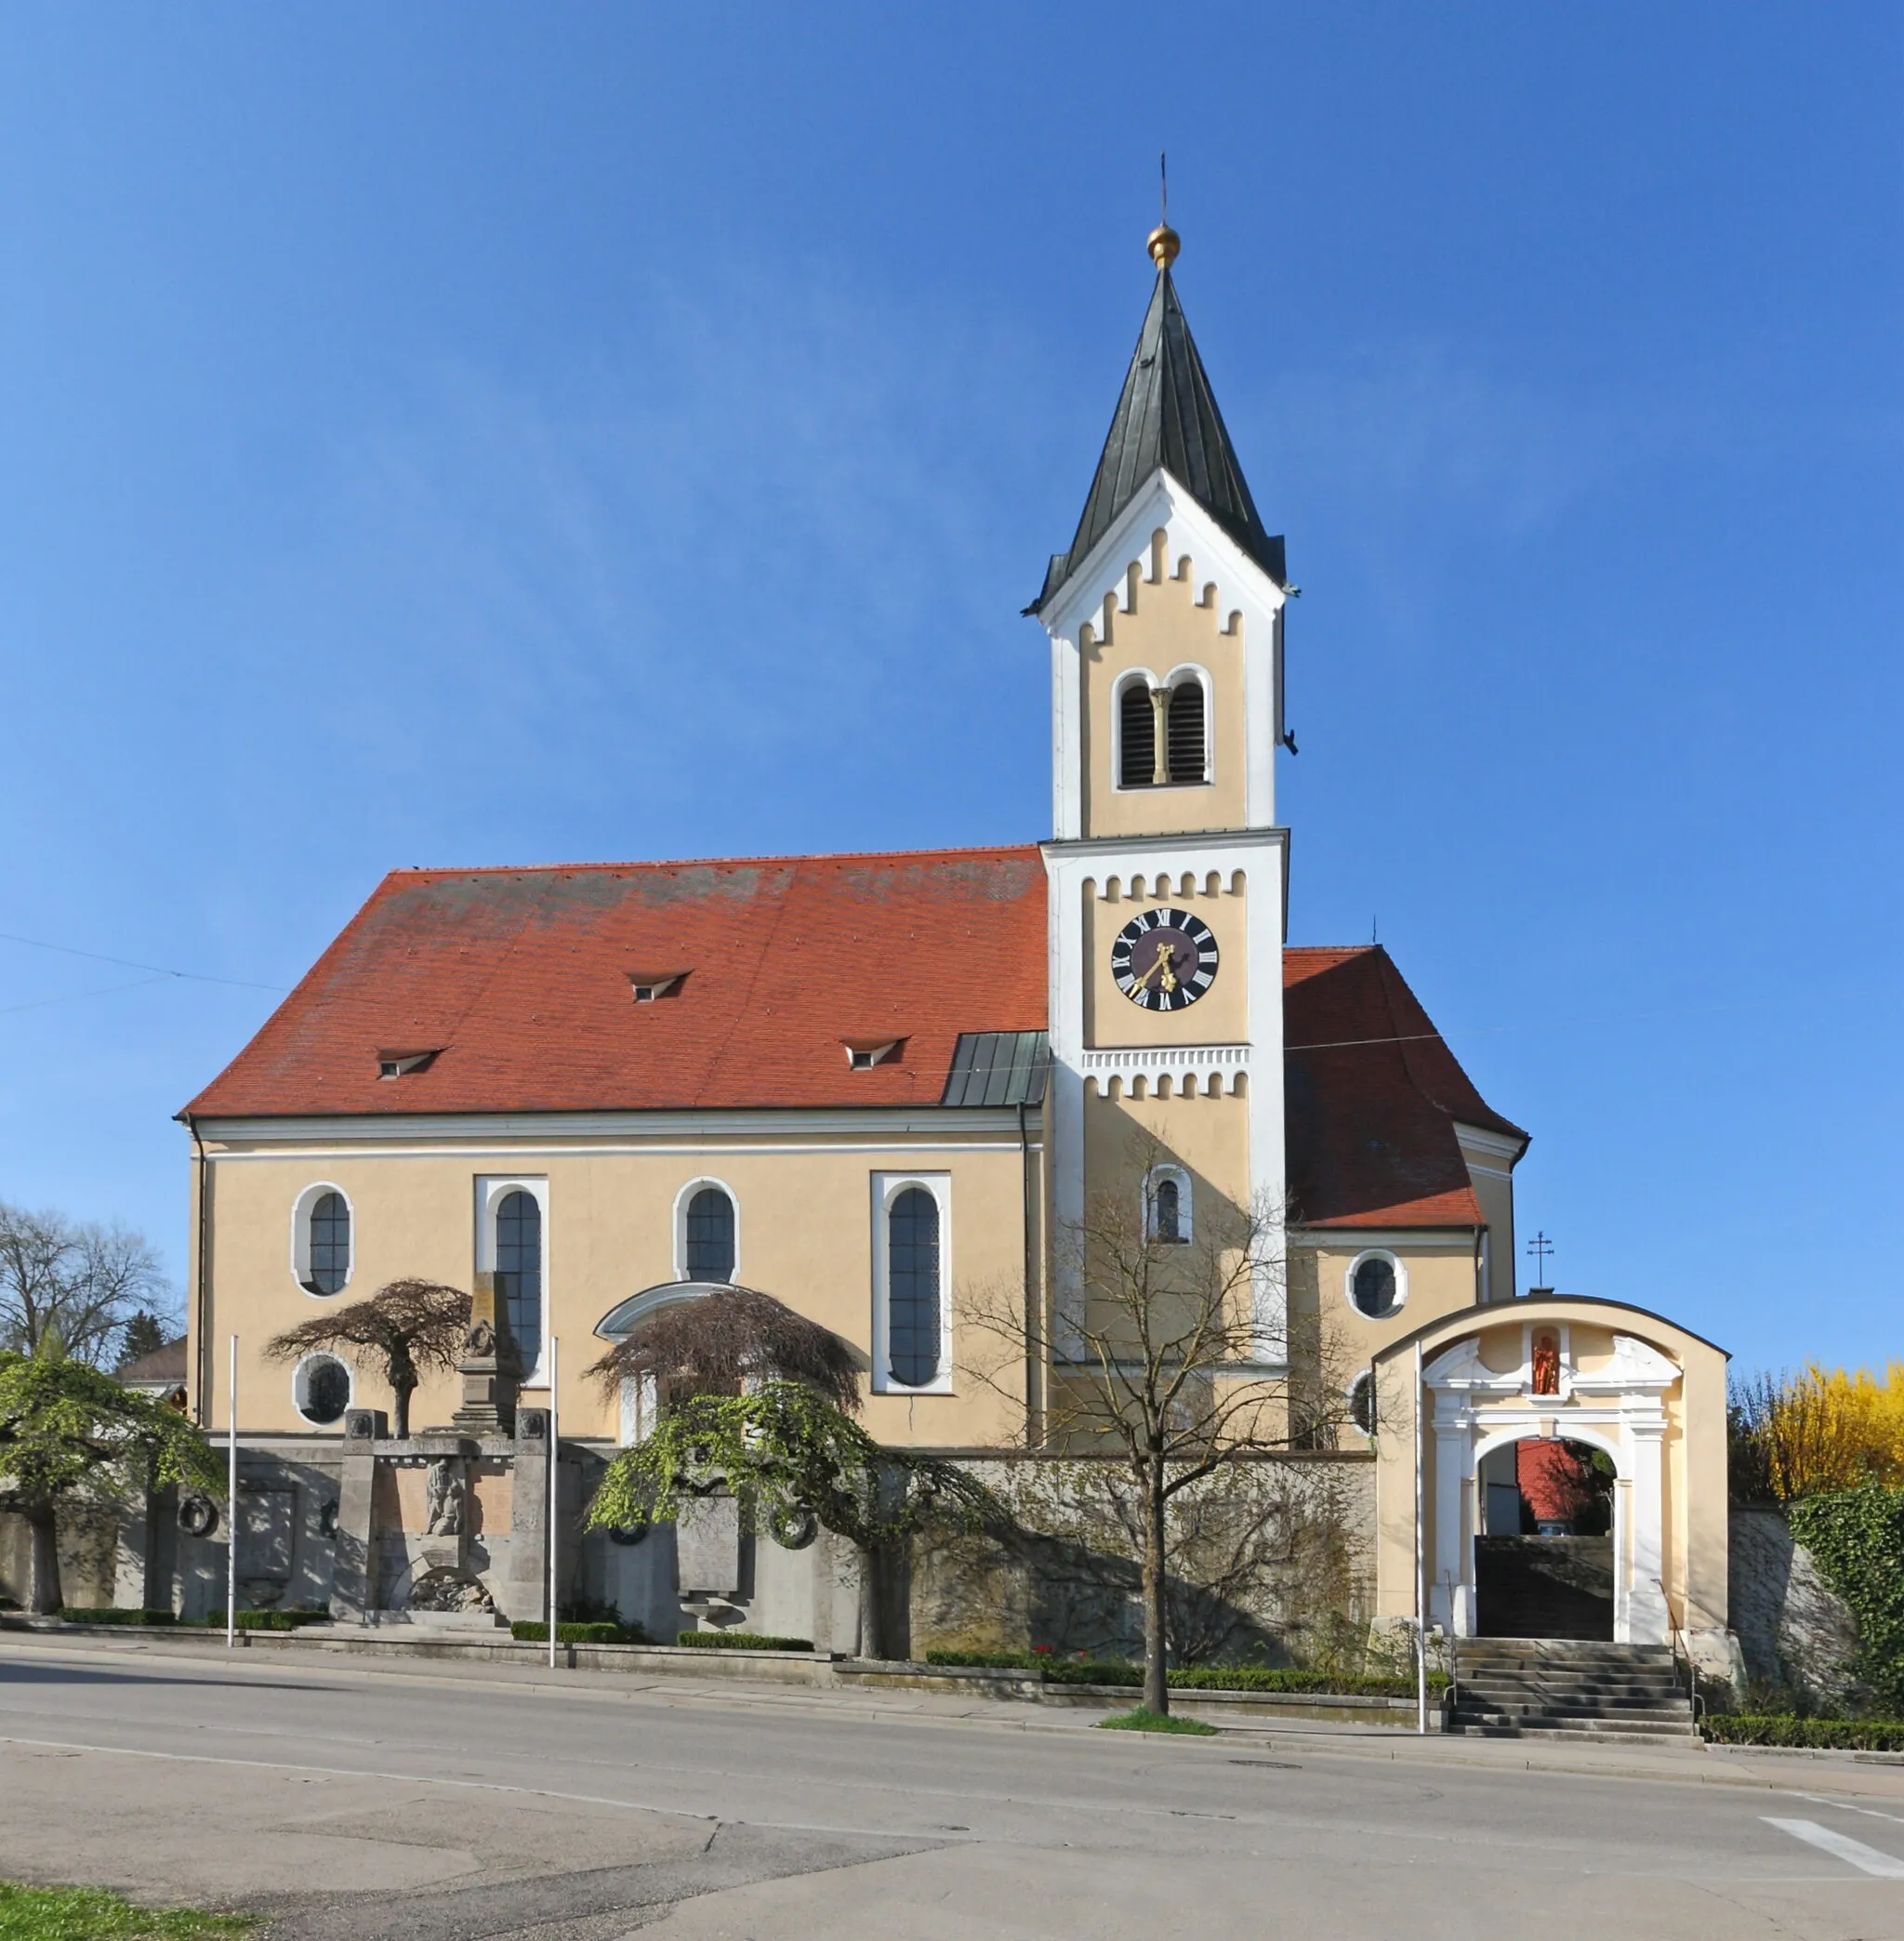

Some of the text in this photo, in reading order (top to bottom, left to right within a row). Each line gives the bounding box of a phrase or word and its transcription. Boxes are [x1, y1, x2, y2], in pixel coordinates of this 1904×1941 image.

[1133, 915, 1150, 934] XI
[1156, 909, 1170, 927] XII
[1180, 913, 1193, 931] I
[1117, 932, 1136, 949] X
[1193, 929, 1211, 944] II
[1113, 956, 1130, 968] IX
[1199, 951, 1217, 963] III
[1159, 993, 1171, 1010] VI
[1183, 987, 1197, 1005] V
